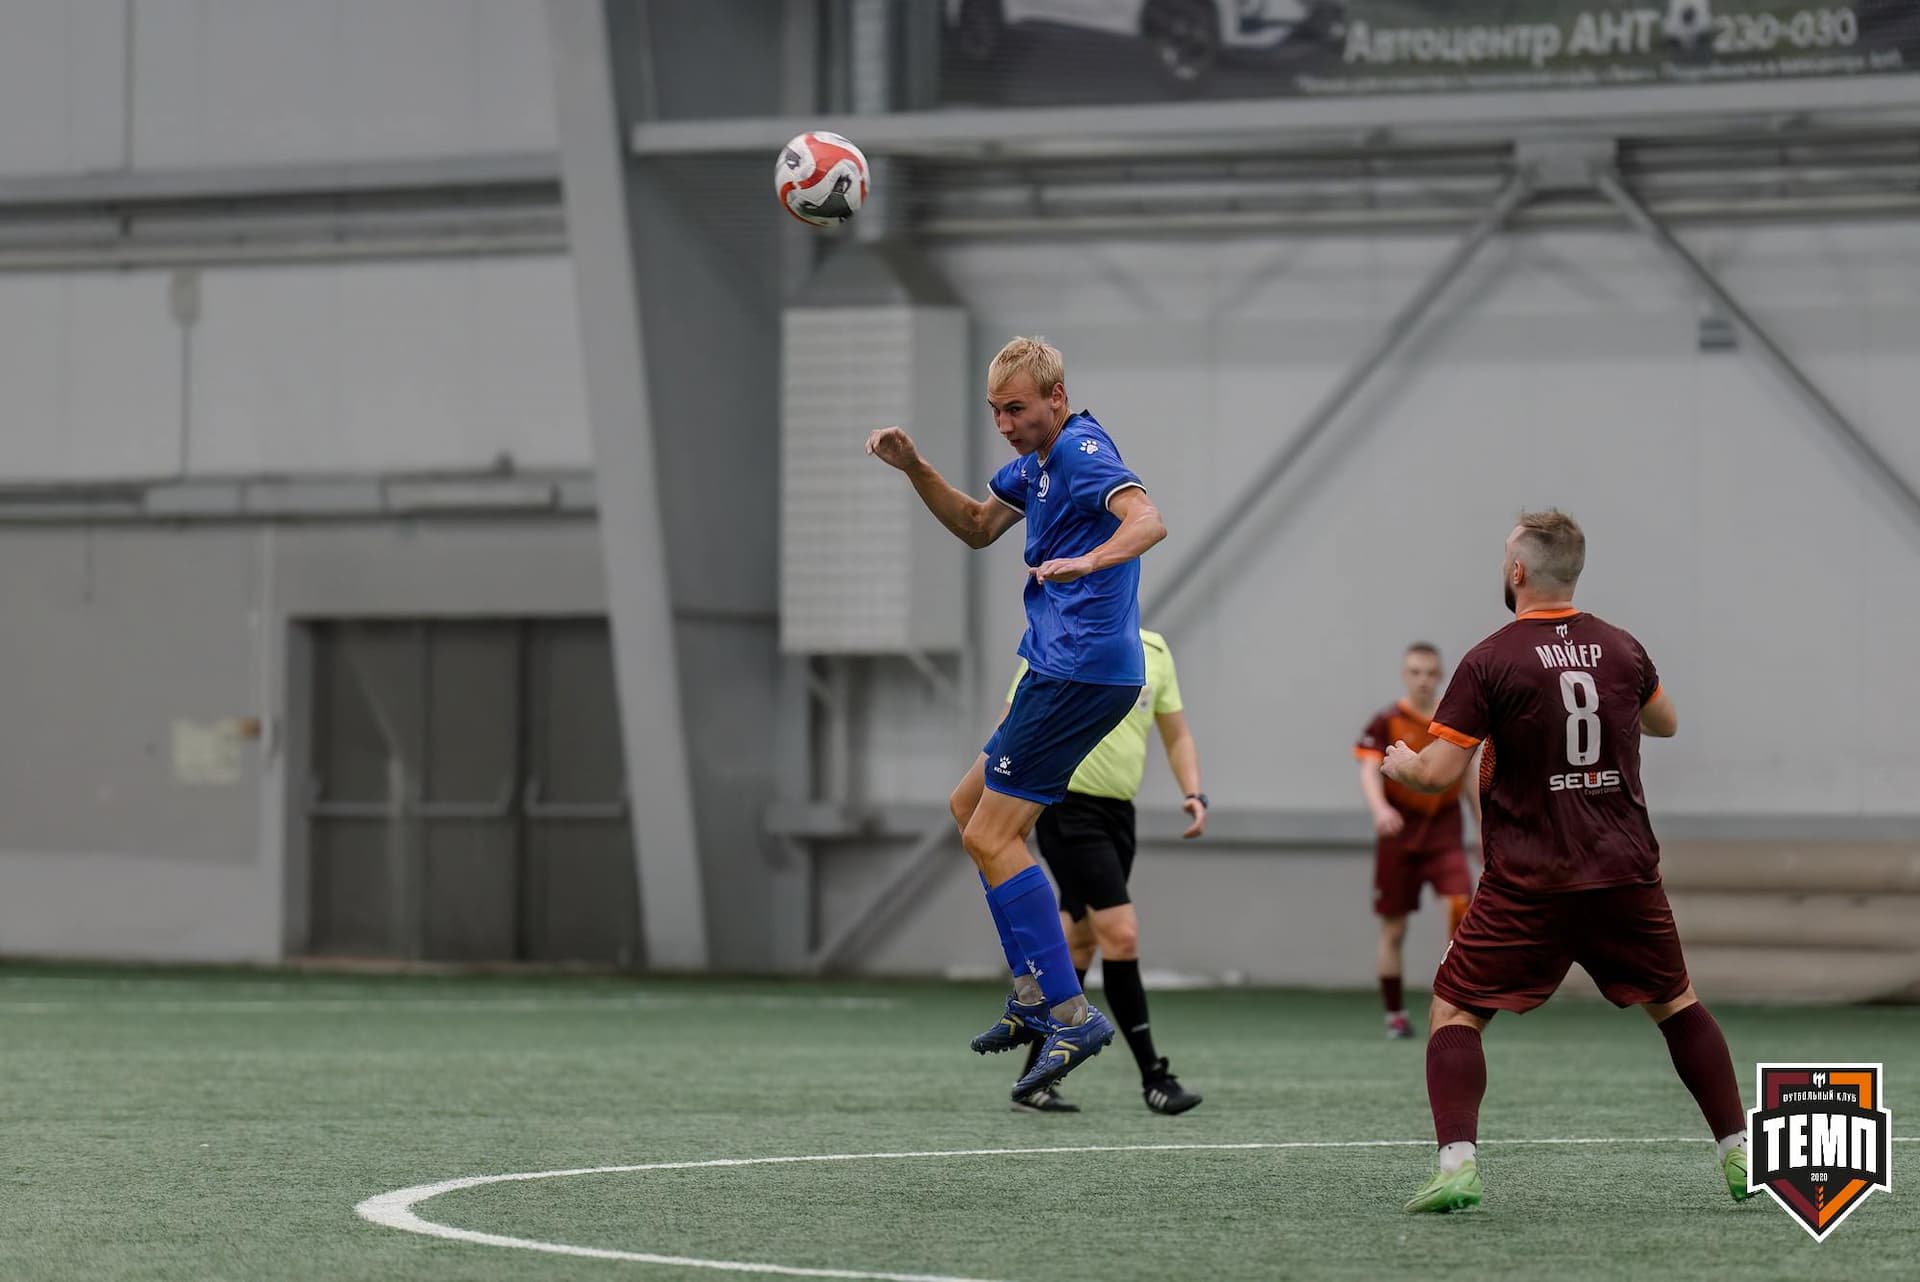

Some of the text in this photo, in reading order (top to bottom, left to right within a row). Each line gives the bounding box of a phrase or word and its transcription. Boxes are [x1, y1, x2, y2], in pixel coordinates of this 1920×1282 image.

[1567, 9, 1660, 57] АНТ
[1712, 7, 1859, 54] 230-030
[1535, 639, 1603, 669] МАЙЕР
[1559, 670, 1601, 767] 8
[1549, 769, 1621, 792] SEUS
